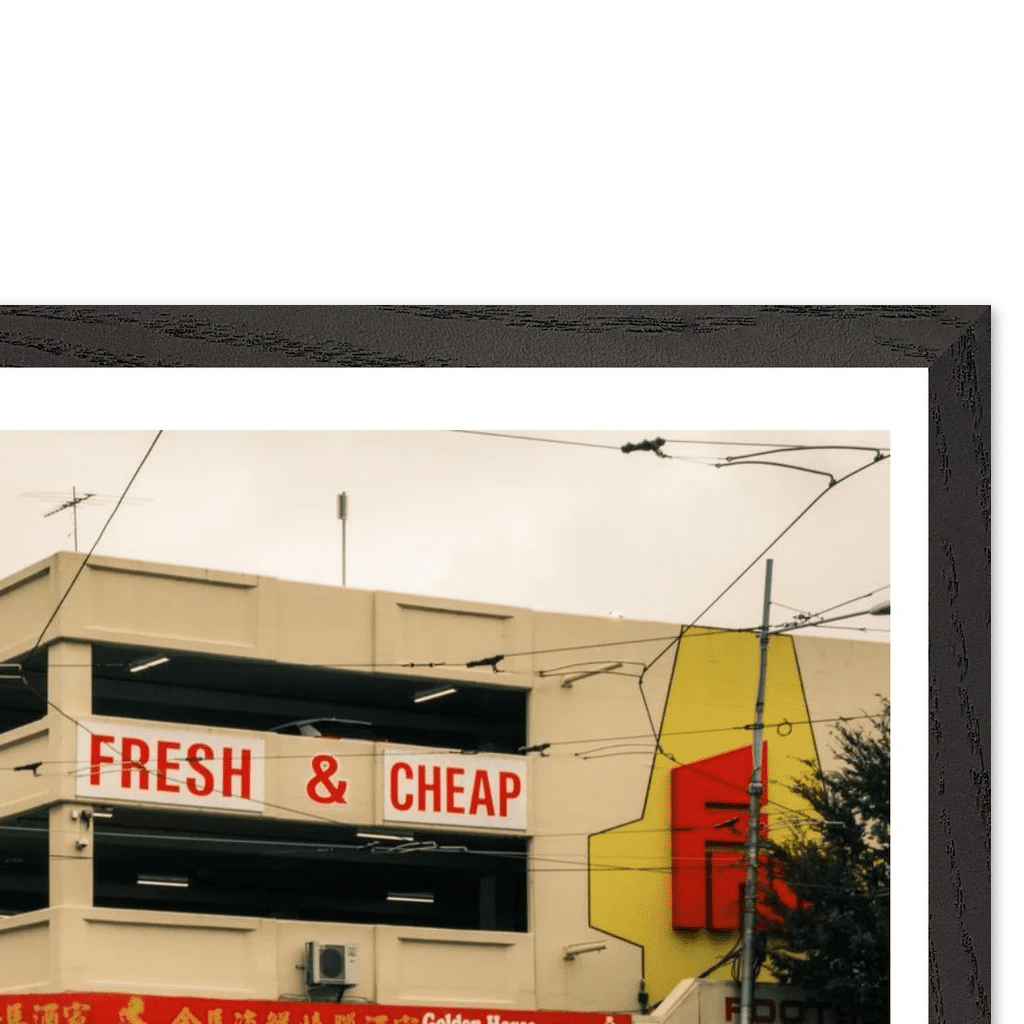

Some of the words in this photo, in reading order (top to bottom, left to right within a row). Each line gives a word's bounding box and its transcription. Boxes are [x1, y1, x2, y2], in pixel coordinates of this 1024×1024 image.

[88, 733, 253, 801] FRESH
[306, 754, 349, 804] &
[389, 761, 523, 818] CHEAP
